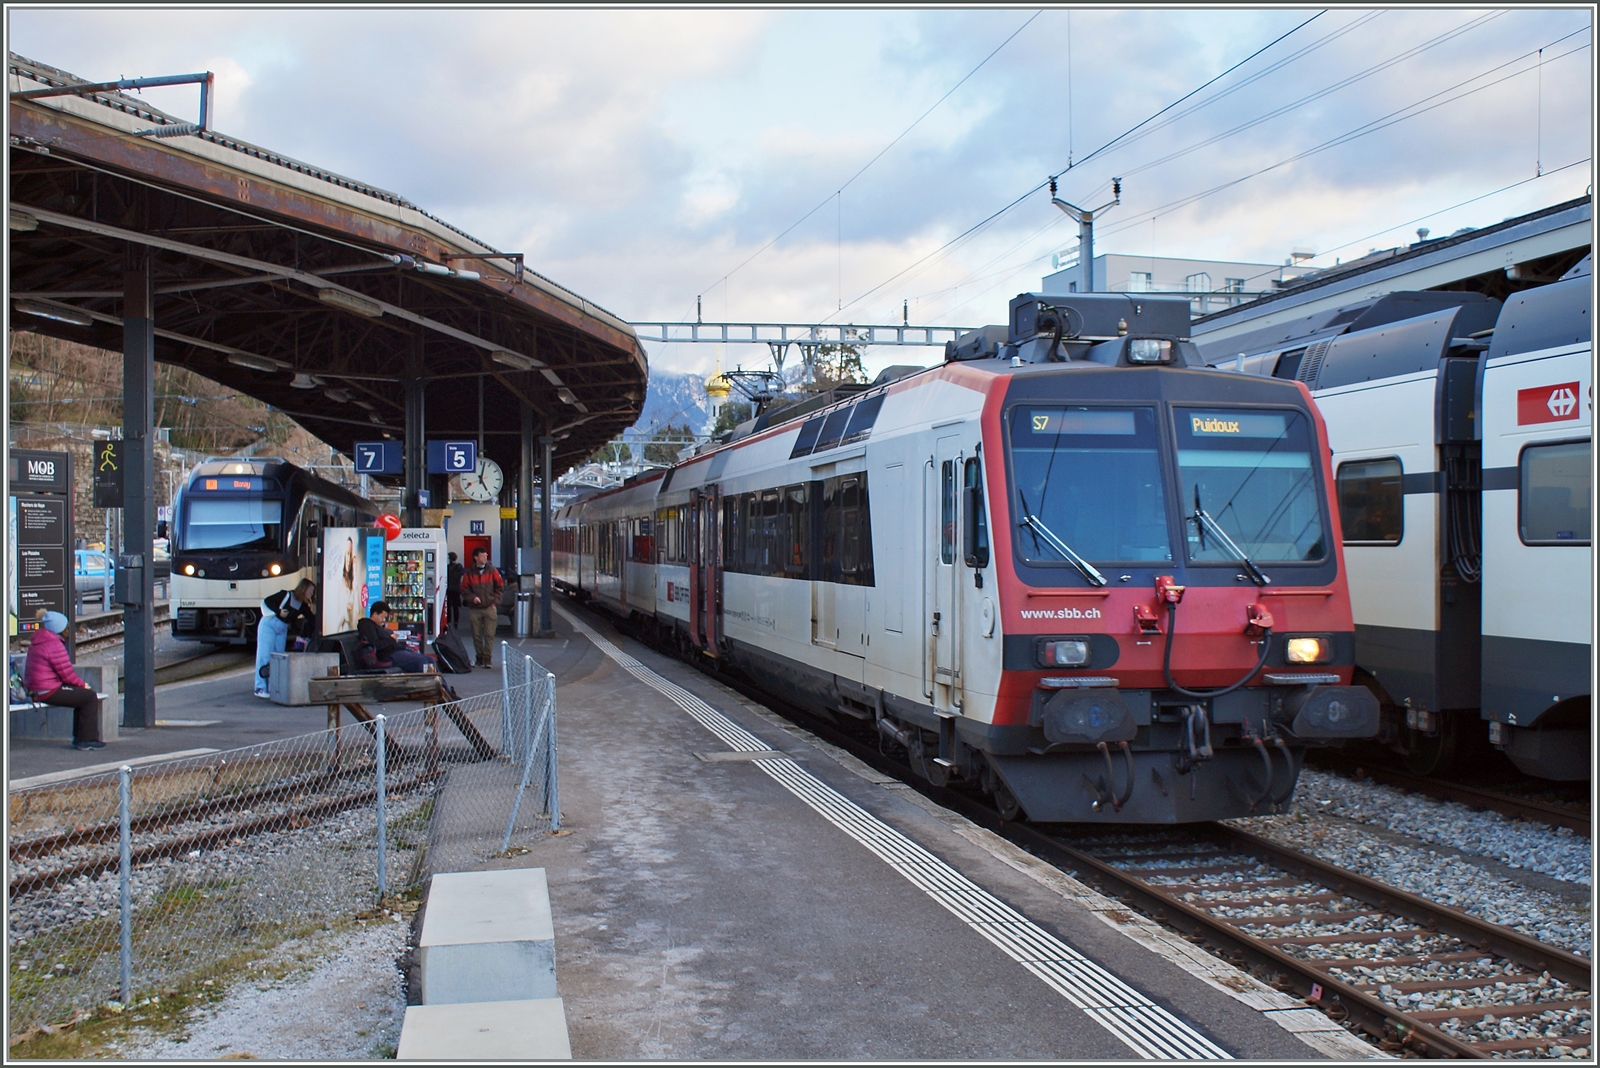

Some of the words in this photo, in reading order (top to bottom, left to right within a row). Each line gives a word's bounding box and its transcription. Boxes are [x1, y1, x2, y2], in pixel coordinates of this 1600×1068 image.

[1033, 415, 1049, 431] S7
[1193, 417, 1240, 433] Puidoux
[364, 451, 376, 468] 7
[453, 450, 466, 468] 5
[28, 460, 55, 475] MOB
[402, 531, 430, 540] selecta
[1021, 608, 1101, 618] www.sbb.ch
